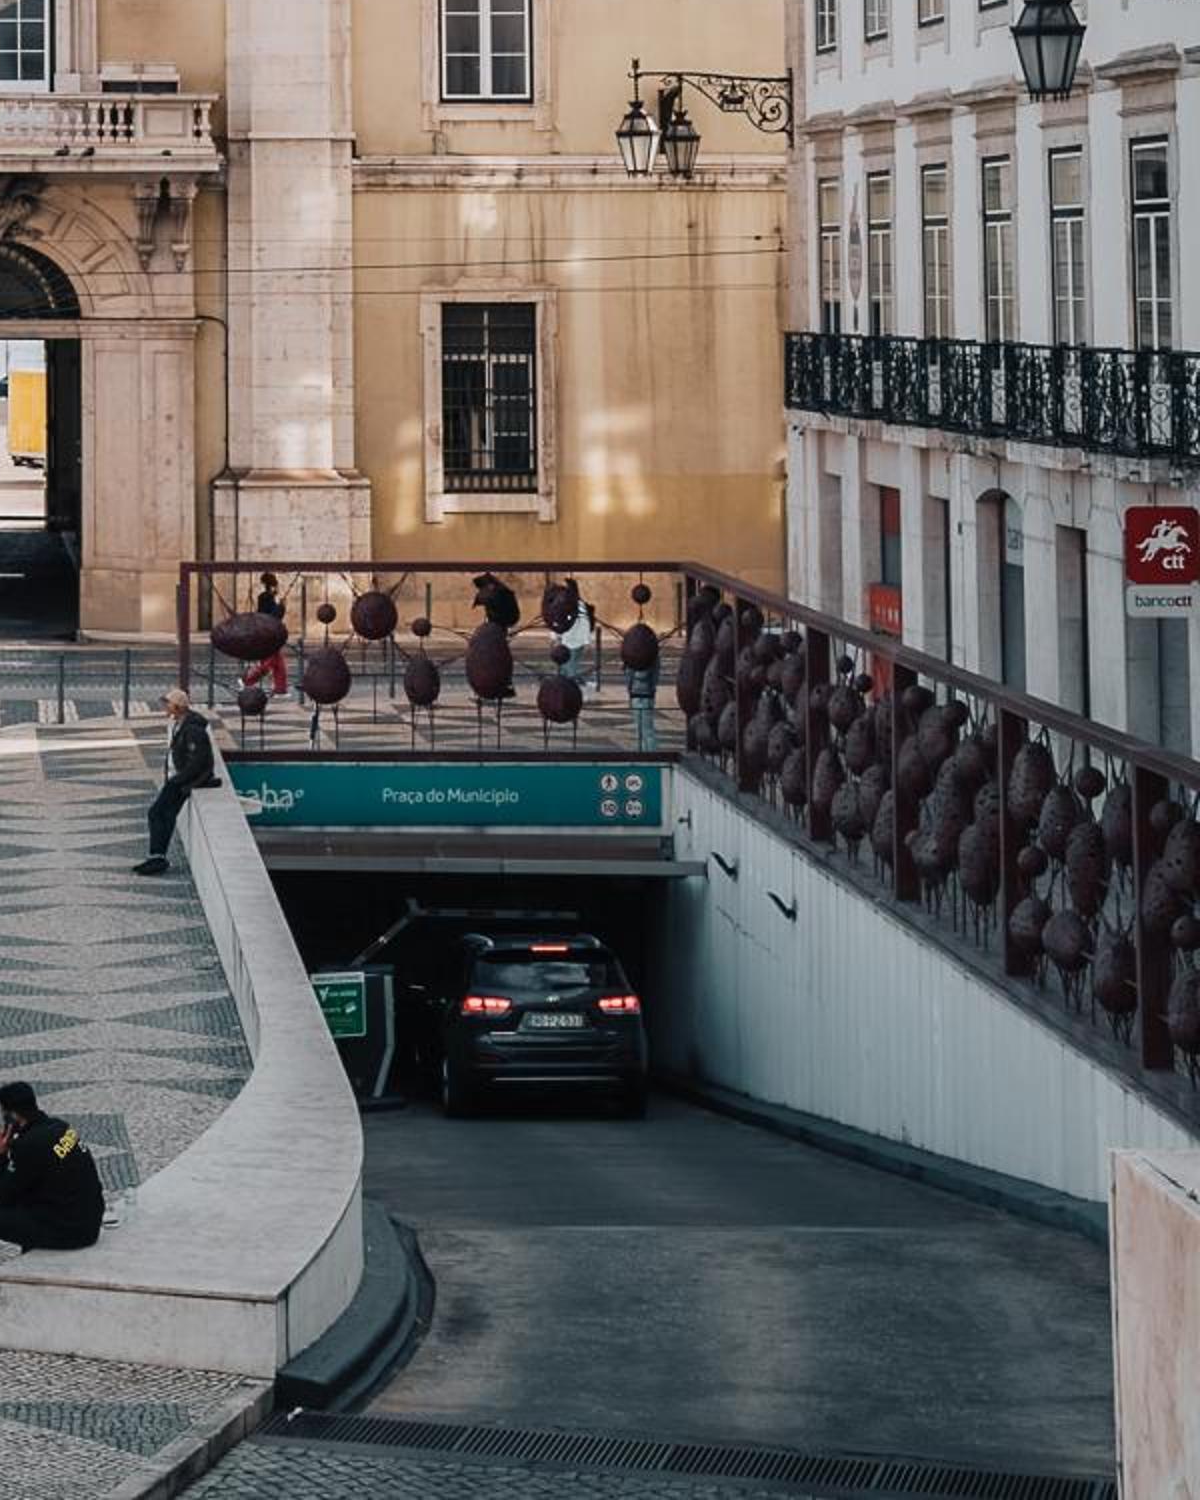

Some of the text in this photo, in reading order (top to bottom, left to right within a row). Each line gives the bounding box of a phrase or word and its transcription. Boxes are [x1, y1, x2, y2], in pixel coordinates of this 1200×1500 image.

[1162, 555, 1185, 570] ctt
[1135, 596, 1192, 607] bancoctt
[382, 788, 423, 804] Praça
[426, 788, 445, 802] do
